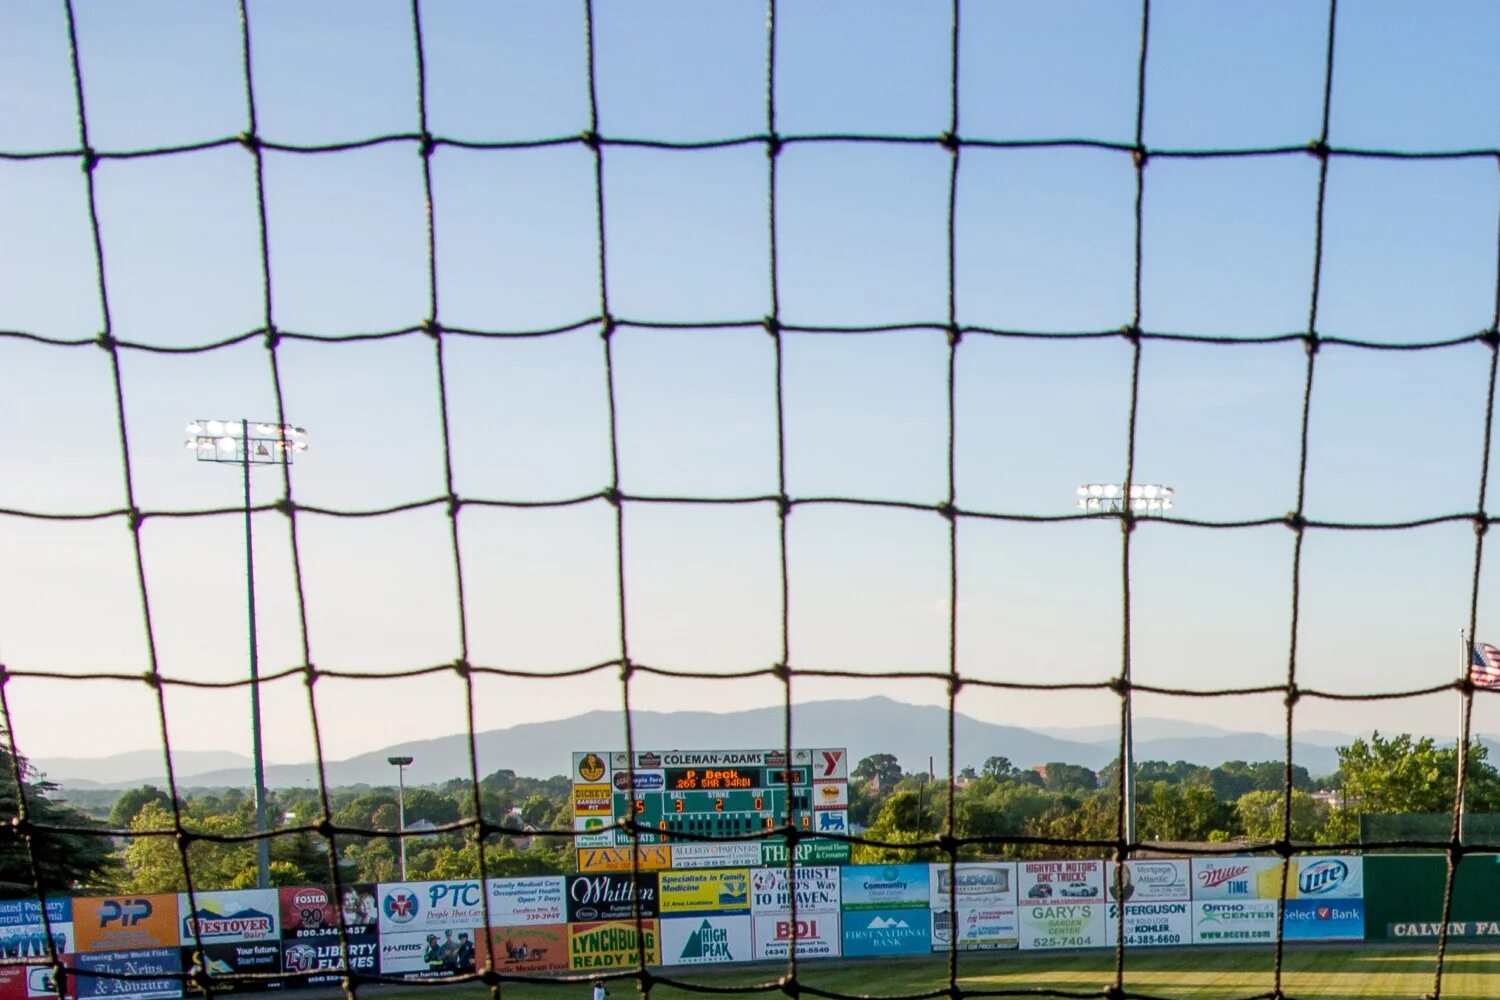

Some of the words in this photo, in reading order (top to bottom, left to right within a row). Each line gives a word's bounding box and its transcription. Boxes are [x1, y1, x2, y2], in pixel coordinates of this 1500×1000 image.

[664, 754, 761, 765] COLEMAN-ADAMS
[706, 769, 738, 779] Beck
[576, 789, 610, 798] DICKEY'S
[675, 799, 683, 813] 3
[715, 798, 723, 812] 2
[1026, 863, 1063, 873] HIGHVIEW
[1066, 862, 1097, 872] MOTORS
[1137, 866, 1171, 876] Mortgage
[662, 875, 707, 883] Specialists
[719, 873, 746, 882] Family
[1037, 873, 1051, 883] GMC
[1057, 872, 1087, 882] TRUCKS
[1138, 876, 1168, 884] Atlantic
[1198, 865, 1249, 888] Miller
[493, 882, 515, 891] Family
[517, 880, 543, 888] Medical
[662, 884, 700, 893] Medicine
[817, 880, 837, 892] Way
[864, 881, 908, 891] Community
[1228, 880, 1248, 894] TIME
[428, 882, 480, 908] PTC
[493, 888, 538, 897] Occupational
[295, 895, 326, 904] FOSTER
[518, 896, 536, 904] Open
[544, 895, 561, 903] Days
[754, 893, 772, 905] TO
[301, 908, 322, 922] 90
[427, 910, 449, 919] People
[450, 909, 467, 918] That
[1032, 905, 1091, 919] GARY'S
[1126, 904, 1186, 916] FERGUSON
[1283, 909, 1316, 920] Select
[1332, 908, 1360, 920] Bank
[1222, 912, 1274, 920] CENTER
[187, 918, 269, 935] WESTOVER
[776, 920, 818, 938] BDI
[1135, 925, 1170, 933] KOHLER
[1394, 922, 1465, 937] CALVIN
[244, 931, 266, 940] Dairy
[702, 928, 727, 942] HIGH
[846, 931, 872, 940] FIRST
[877, 929, 928, 938] NATIONAL
[873, 938, 901, 947] BANK
[1033, 936, 1092, 946] 525-7404
[236, 946, 253, 955] Your
[383, 943, 423, 952] HARRIS
[702, 942, 733, 960] PEAK
[765, 949, 787, 957] (434)
[237, 957, 255, 966] Start
[573, 954, 623, 968] READY
[125, 961, 163, 975] News
[112, 977, 169, 994] Advance
